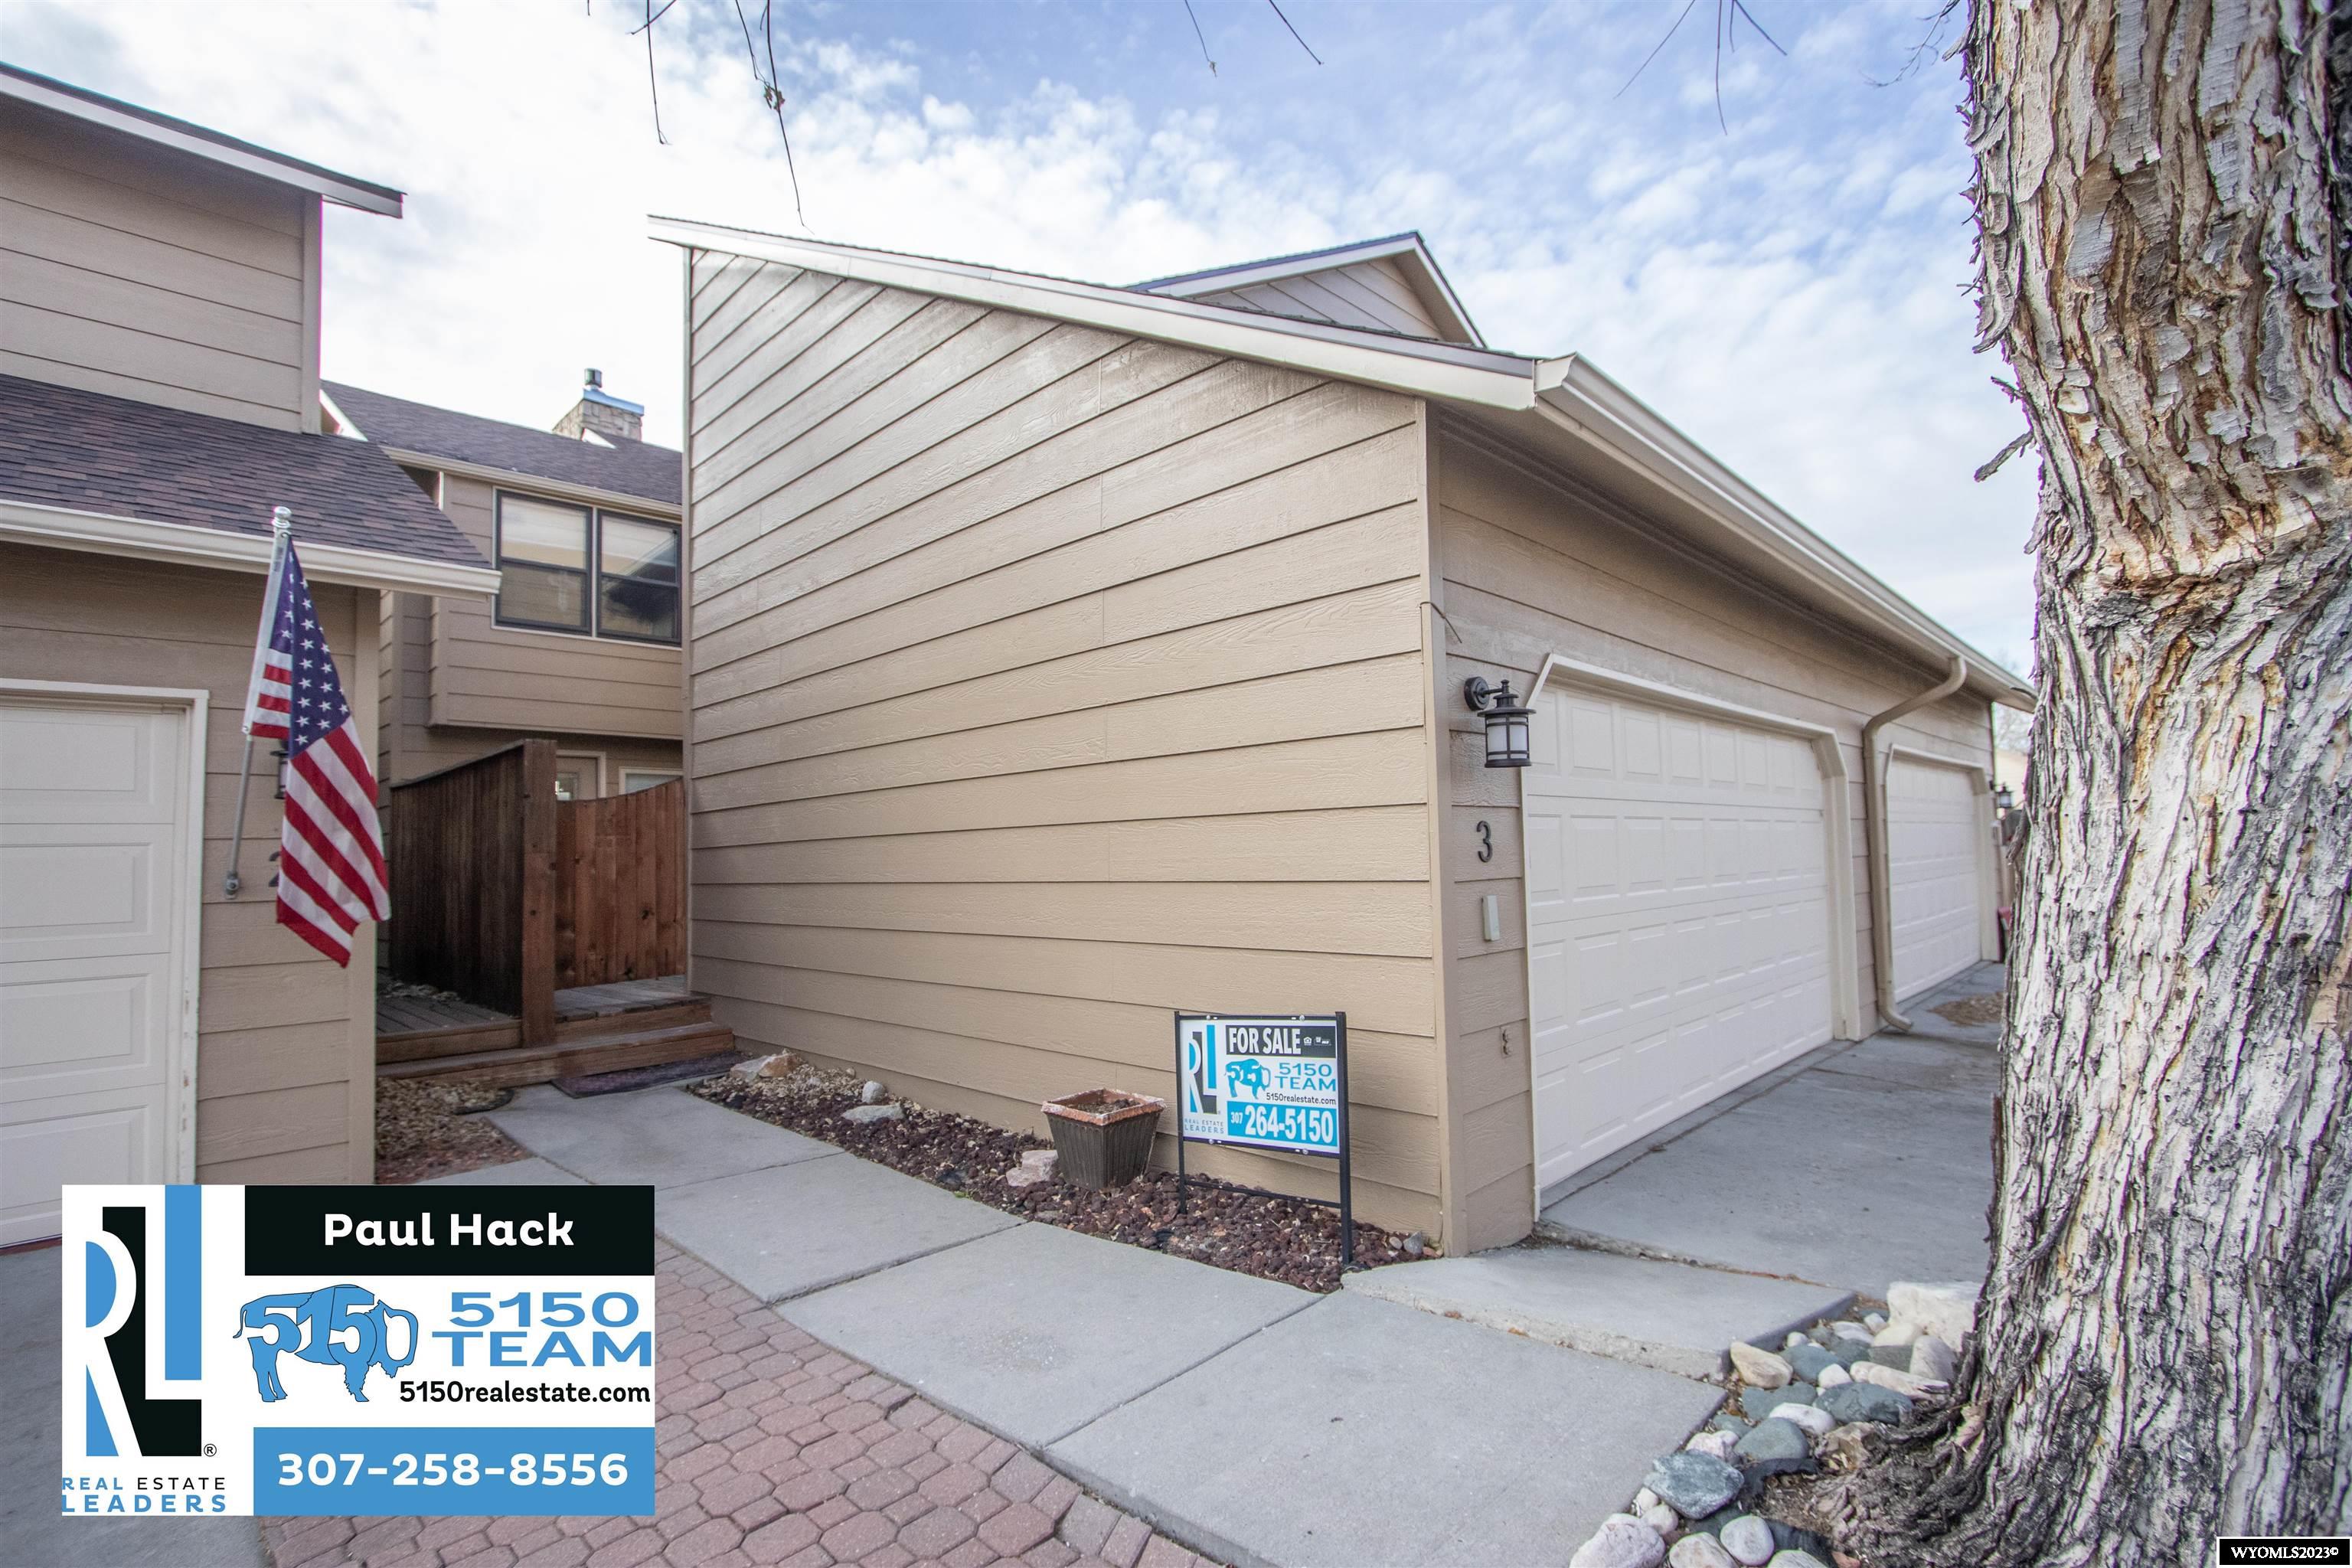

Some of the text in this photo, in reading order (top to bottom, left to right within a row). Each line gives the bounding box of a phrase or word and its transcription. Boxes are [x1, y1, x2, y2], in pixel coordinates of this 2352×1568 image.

[1476, 820, 1492, 863] 3
[1229, 1027, 1302, 1055] FOR SALE
[1279, 1062, 1332, 1077] 5150
[1274, 1076, 1337, 1092] TEAM
[1266, 1092, 1337, 1105] 5150realestate.com
[1184, 1124, 1225, 1134] LEADERS
[1230, 1105, 1334, 1144] 307 264-5150
